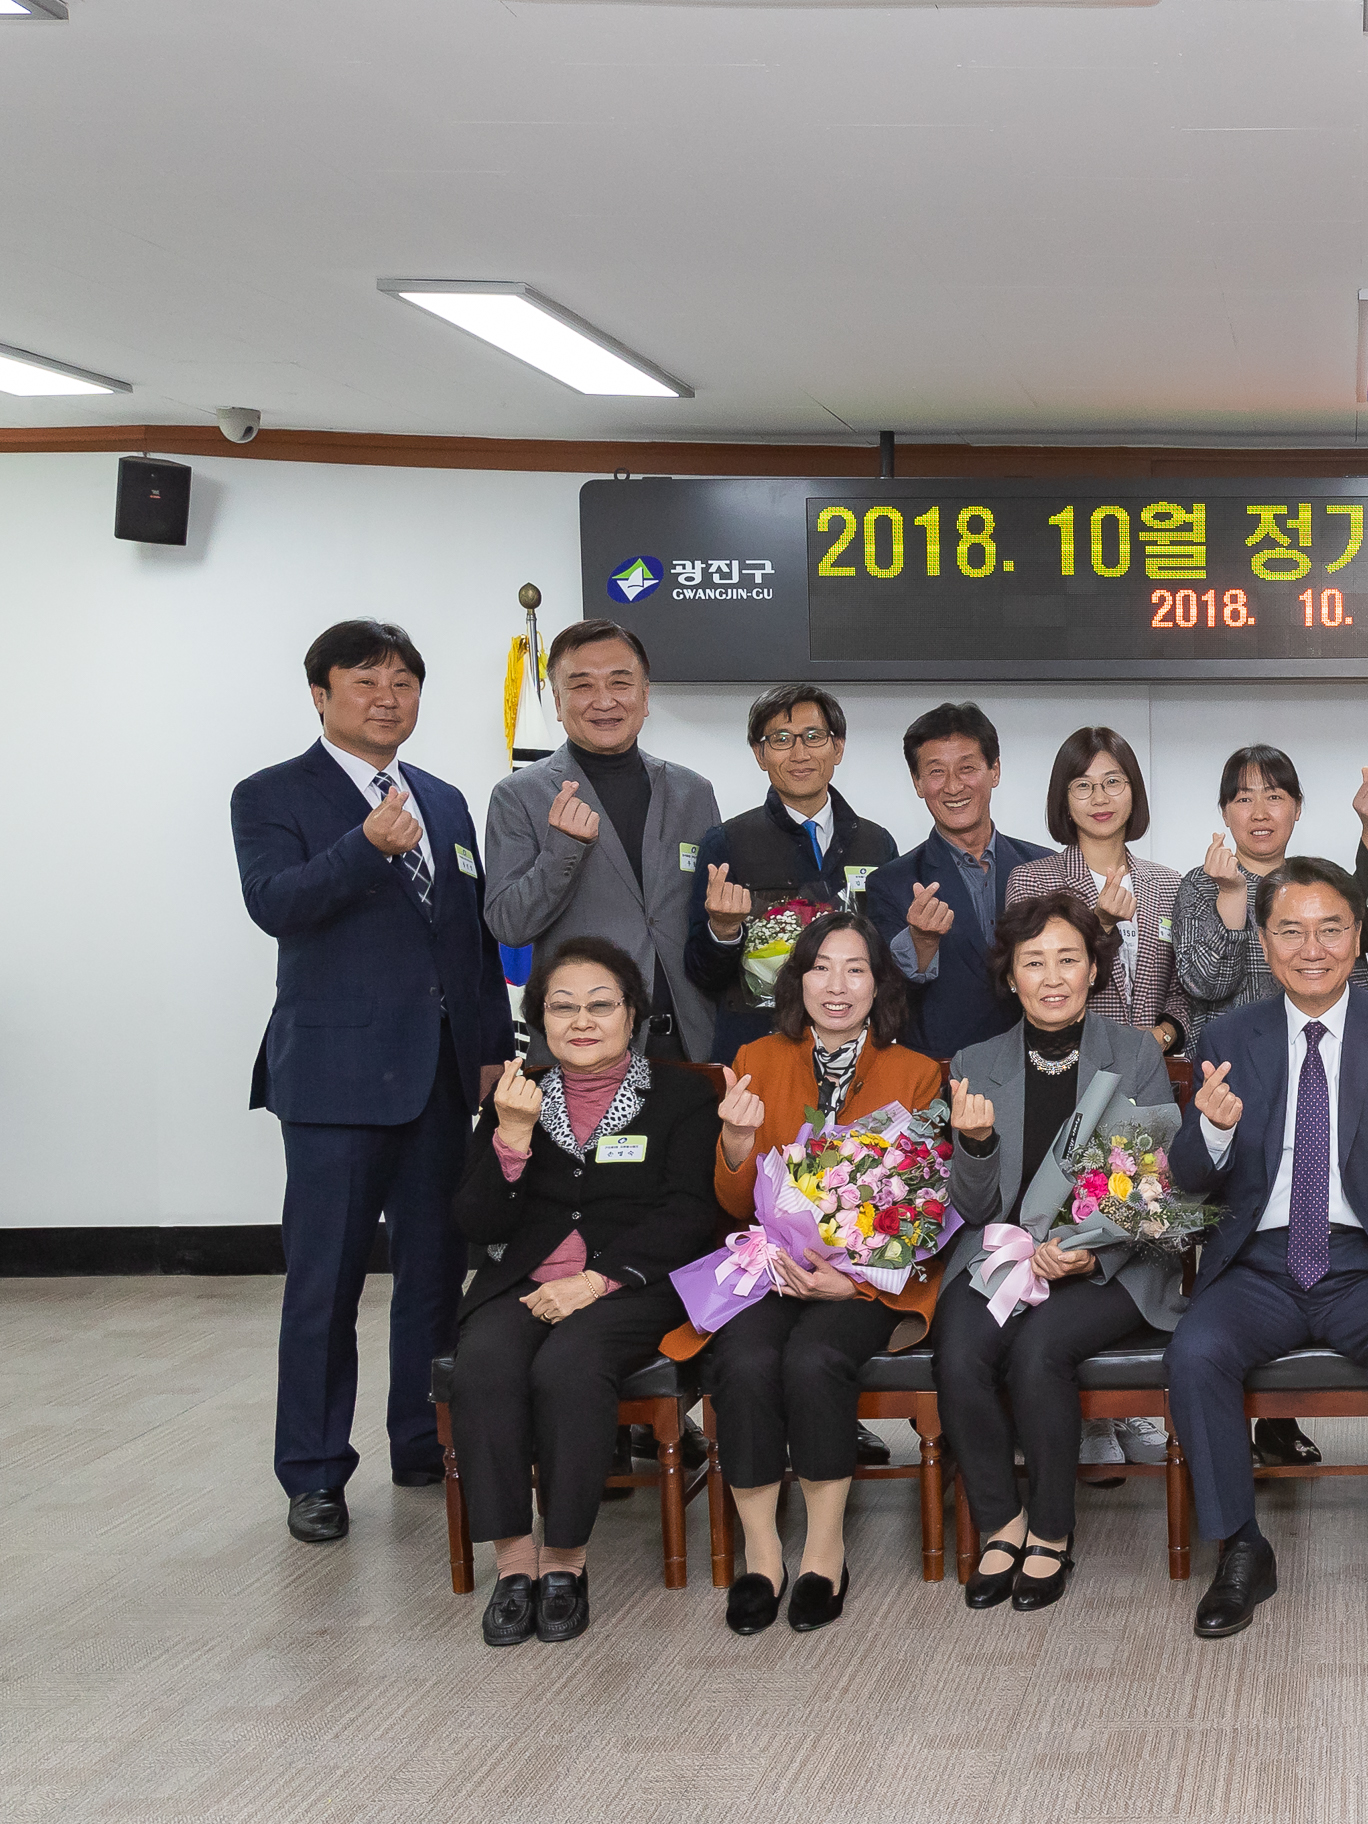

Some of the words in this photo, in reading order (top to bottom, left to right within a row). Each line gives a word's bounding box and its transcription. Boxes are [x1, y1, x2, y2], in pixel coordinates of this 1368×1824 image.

[817, 505, 1014, 579] 2018.
[1048, 502, 1207, 580] 10월
[670, 559, 776, 586] 광진구
[672, 588, 773, 600] GWANGJIN-GU
[1150, 588, 1256, 628] 2018.
[1298, 588, 1354, 627] 10.
